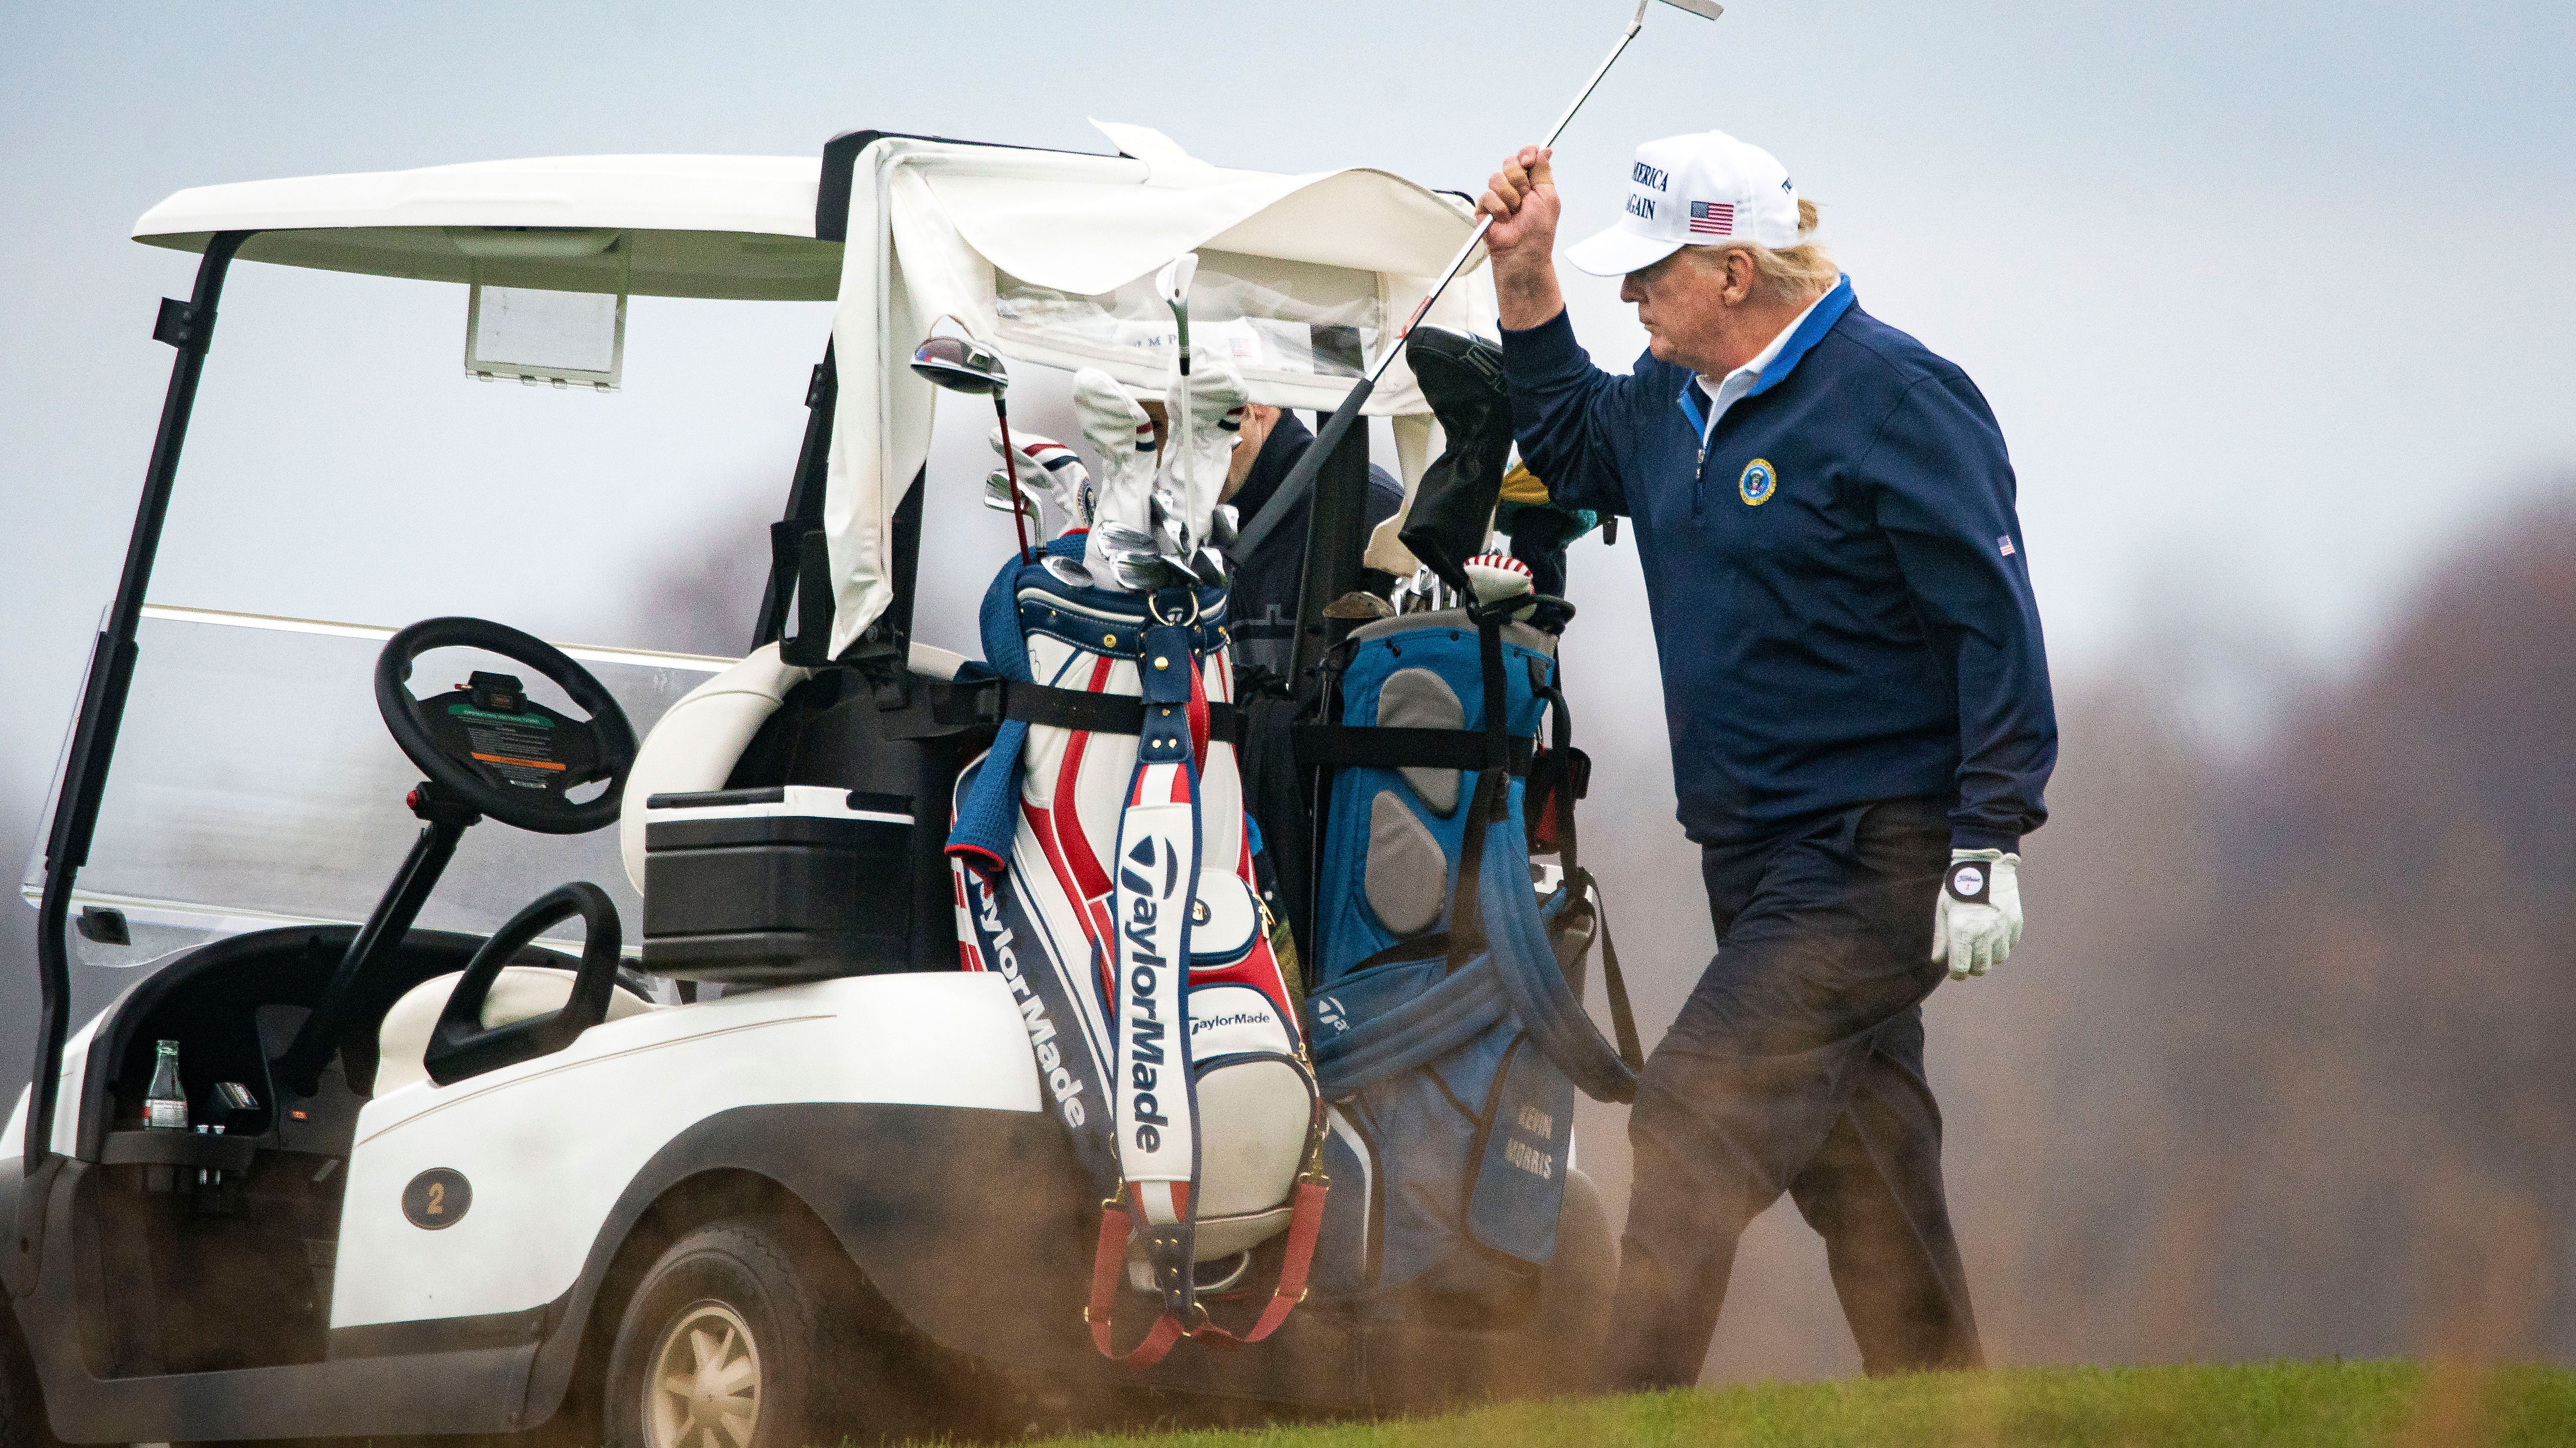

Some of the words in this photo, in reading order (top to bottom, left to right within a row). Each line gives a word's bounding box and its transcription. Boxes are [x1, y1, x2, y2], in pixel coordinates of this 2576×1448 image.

[1631, 160, 1669, 192] MERICA
[1121, 835, 1178, 1154] TaylorMade
[427, 1182, 444, 1214] 2
